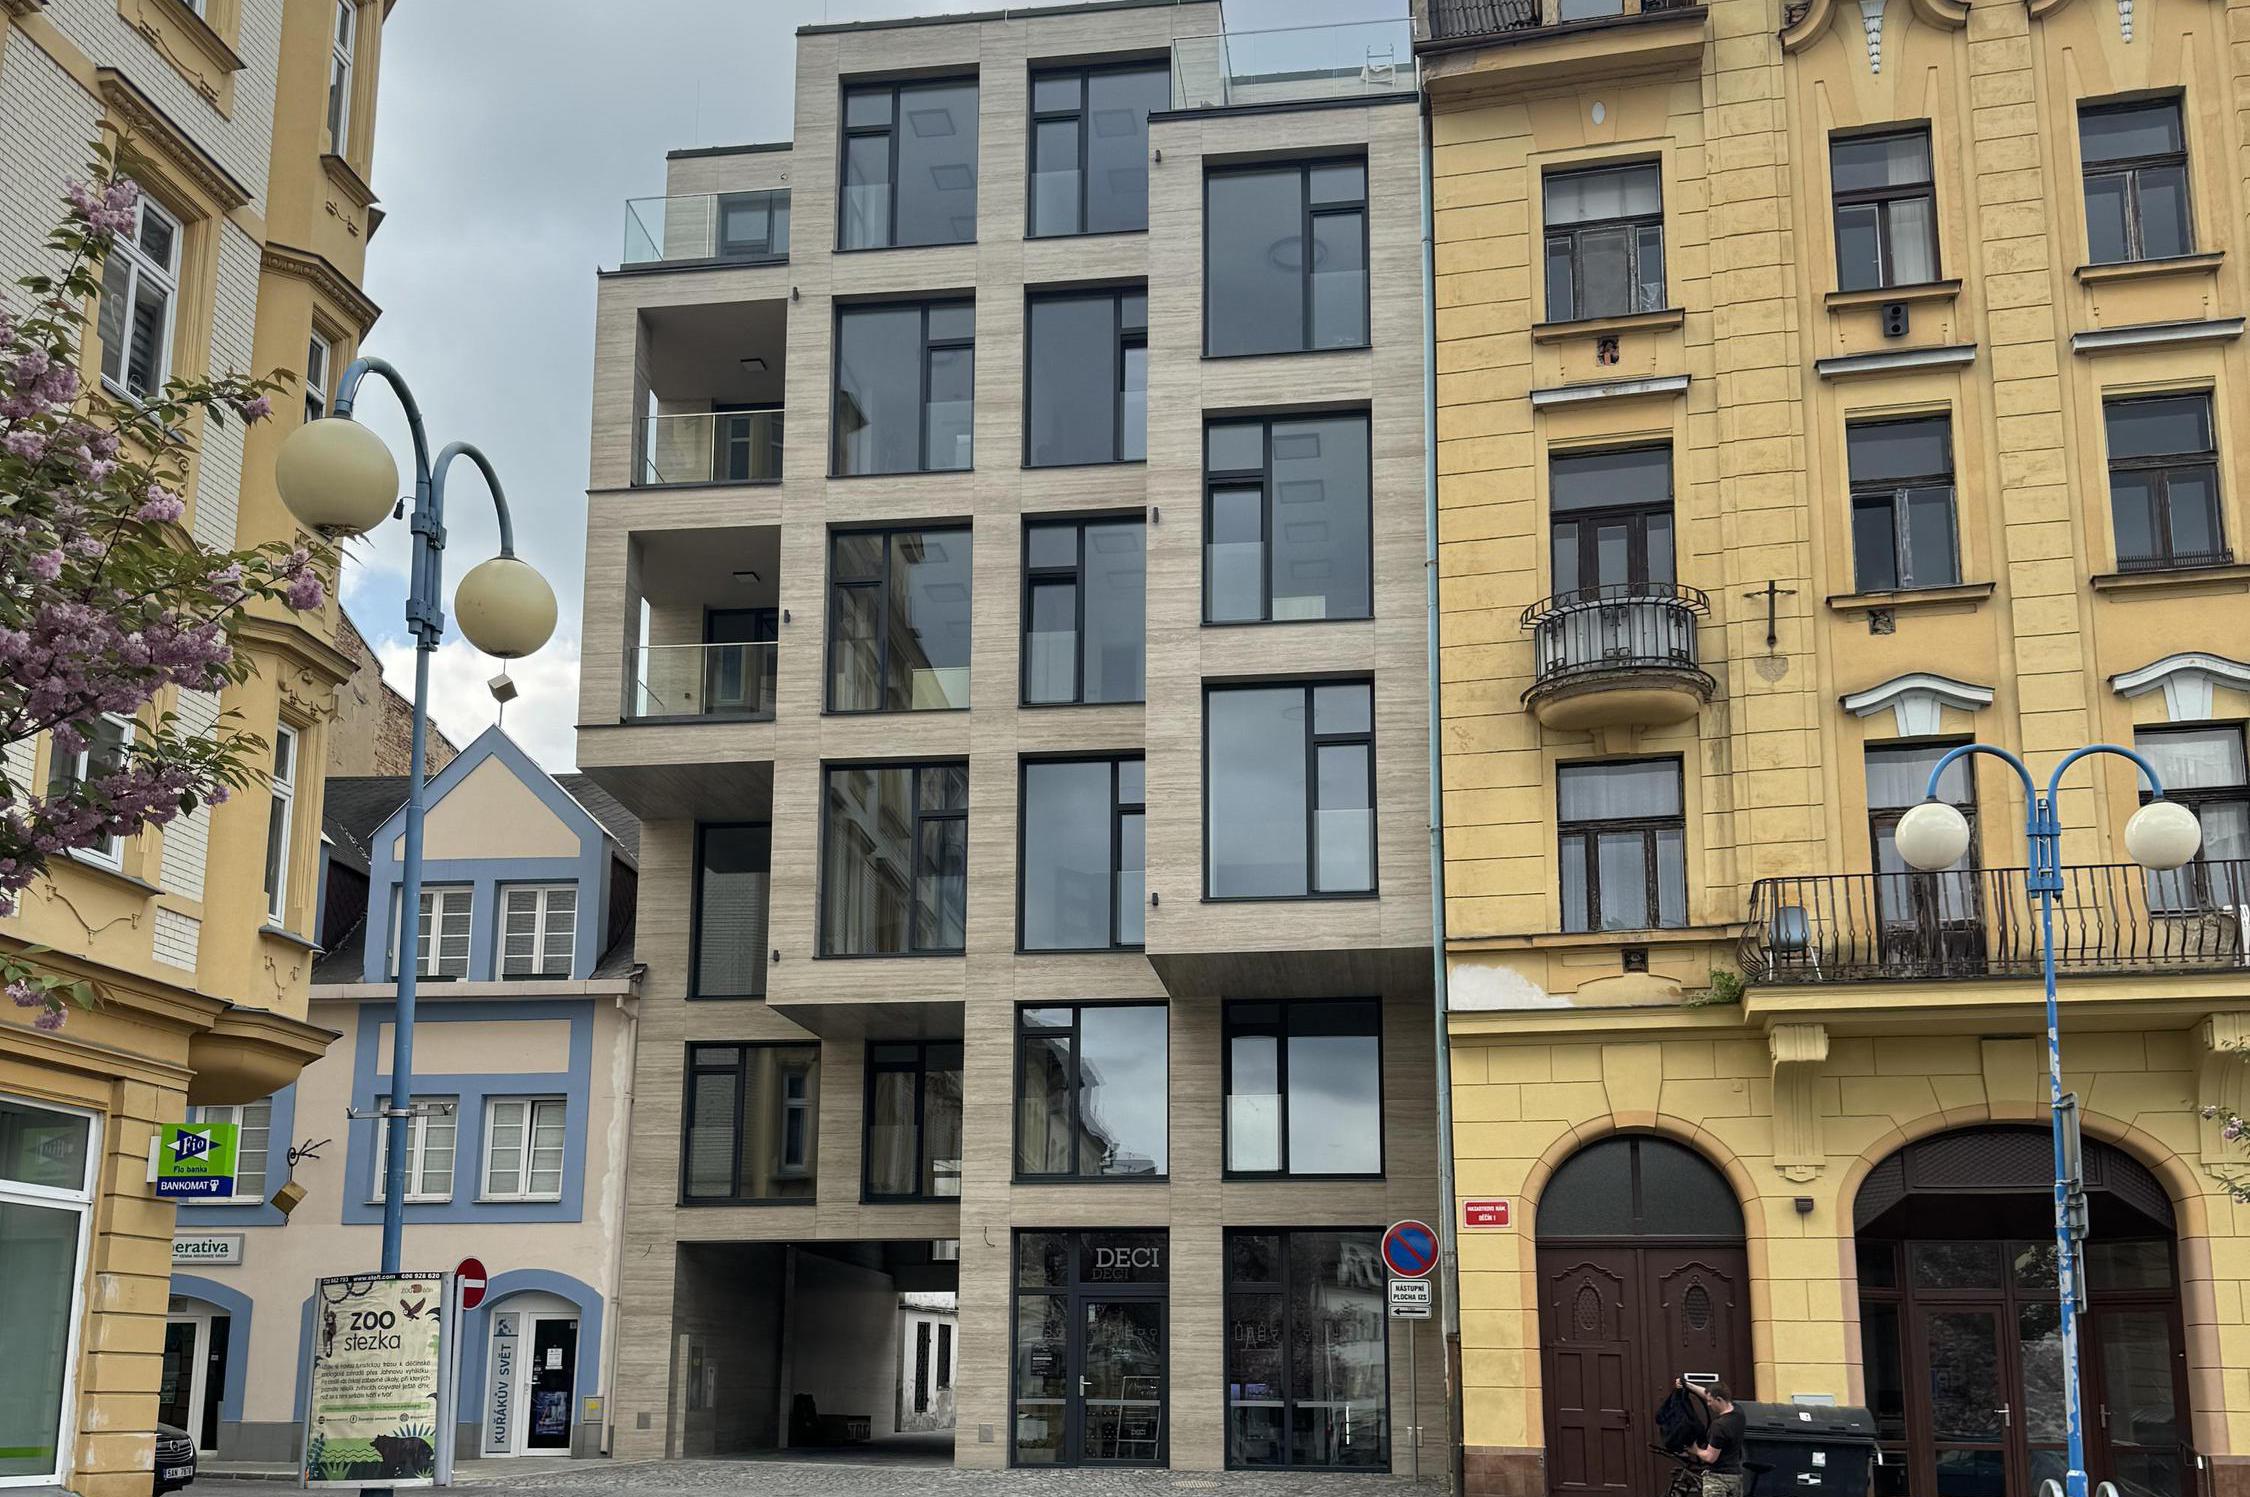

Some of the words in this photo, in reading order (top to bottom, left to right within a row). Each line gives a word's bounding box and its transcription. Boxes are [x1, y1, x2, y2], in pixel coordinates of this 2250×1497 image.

[182, 1136, 204, 1155] Fio
[161, 1181, 209, 1190] BANKOMAT
[1096, 1247, 1160, 1268] DECI
[344, 1330, 401, 1351] stezka
[499, 1344, 511, 1375] SVĚT
[494, 1382, 509, 1443] KUŘÁKŮV
